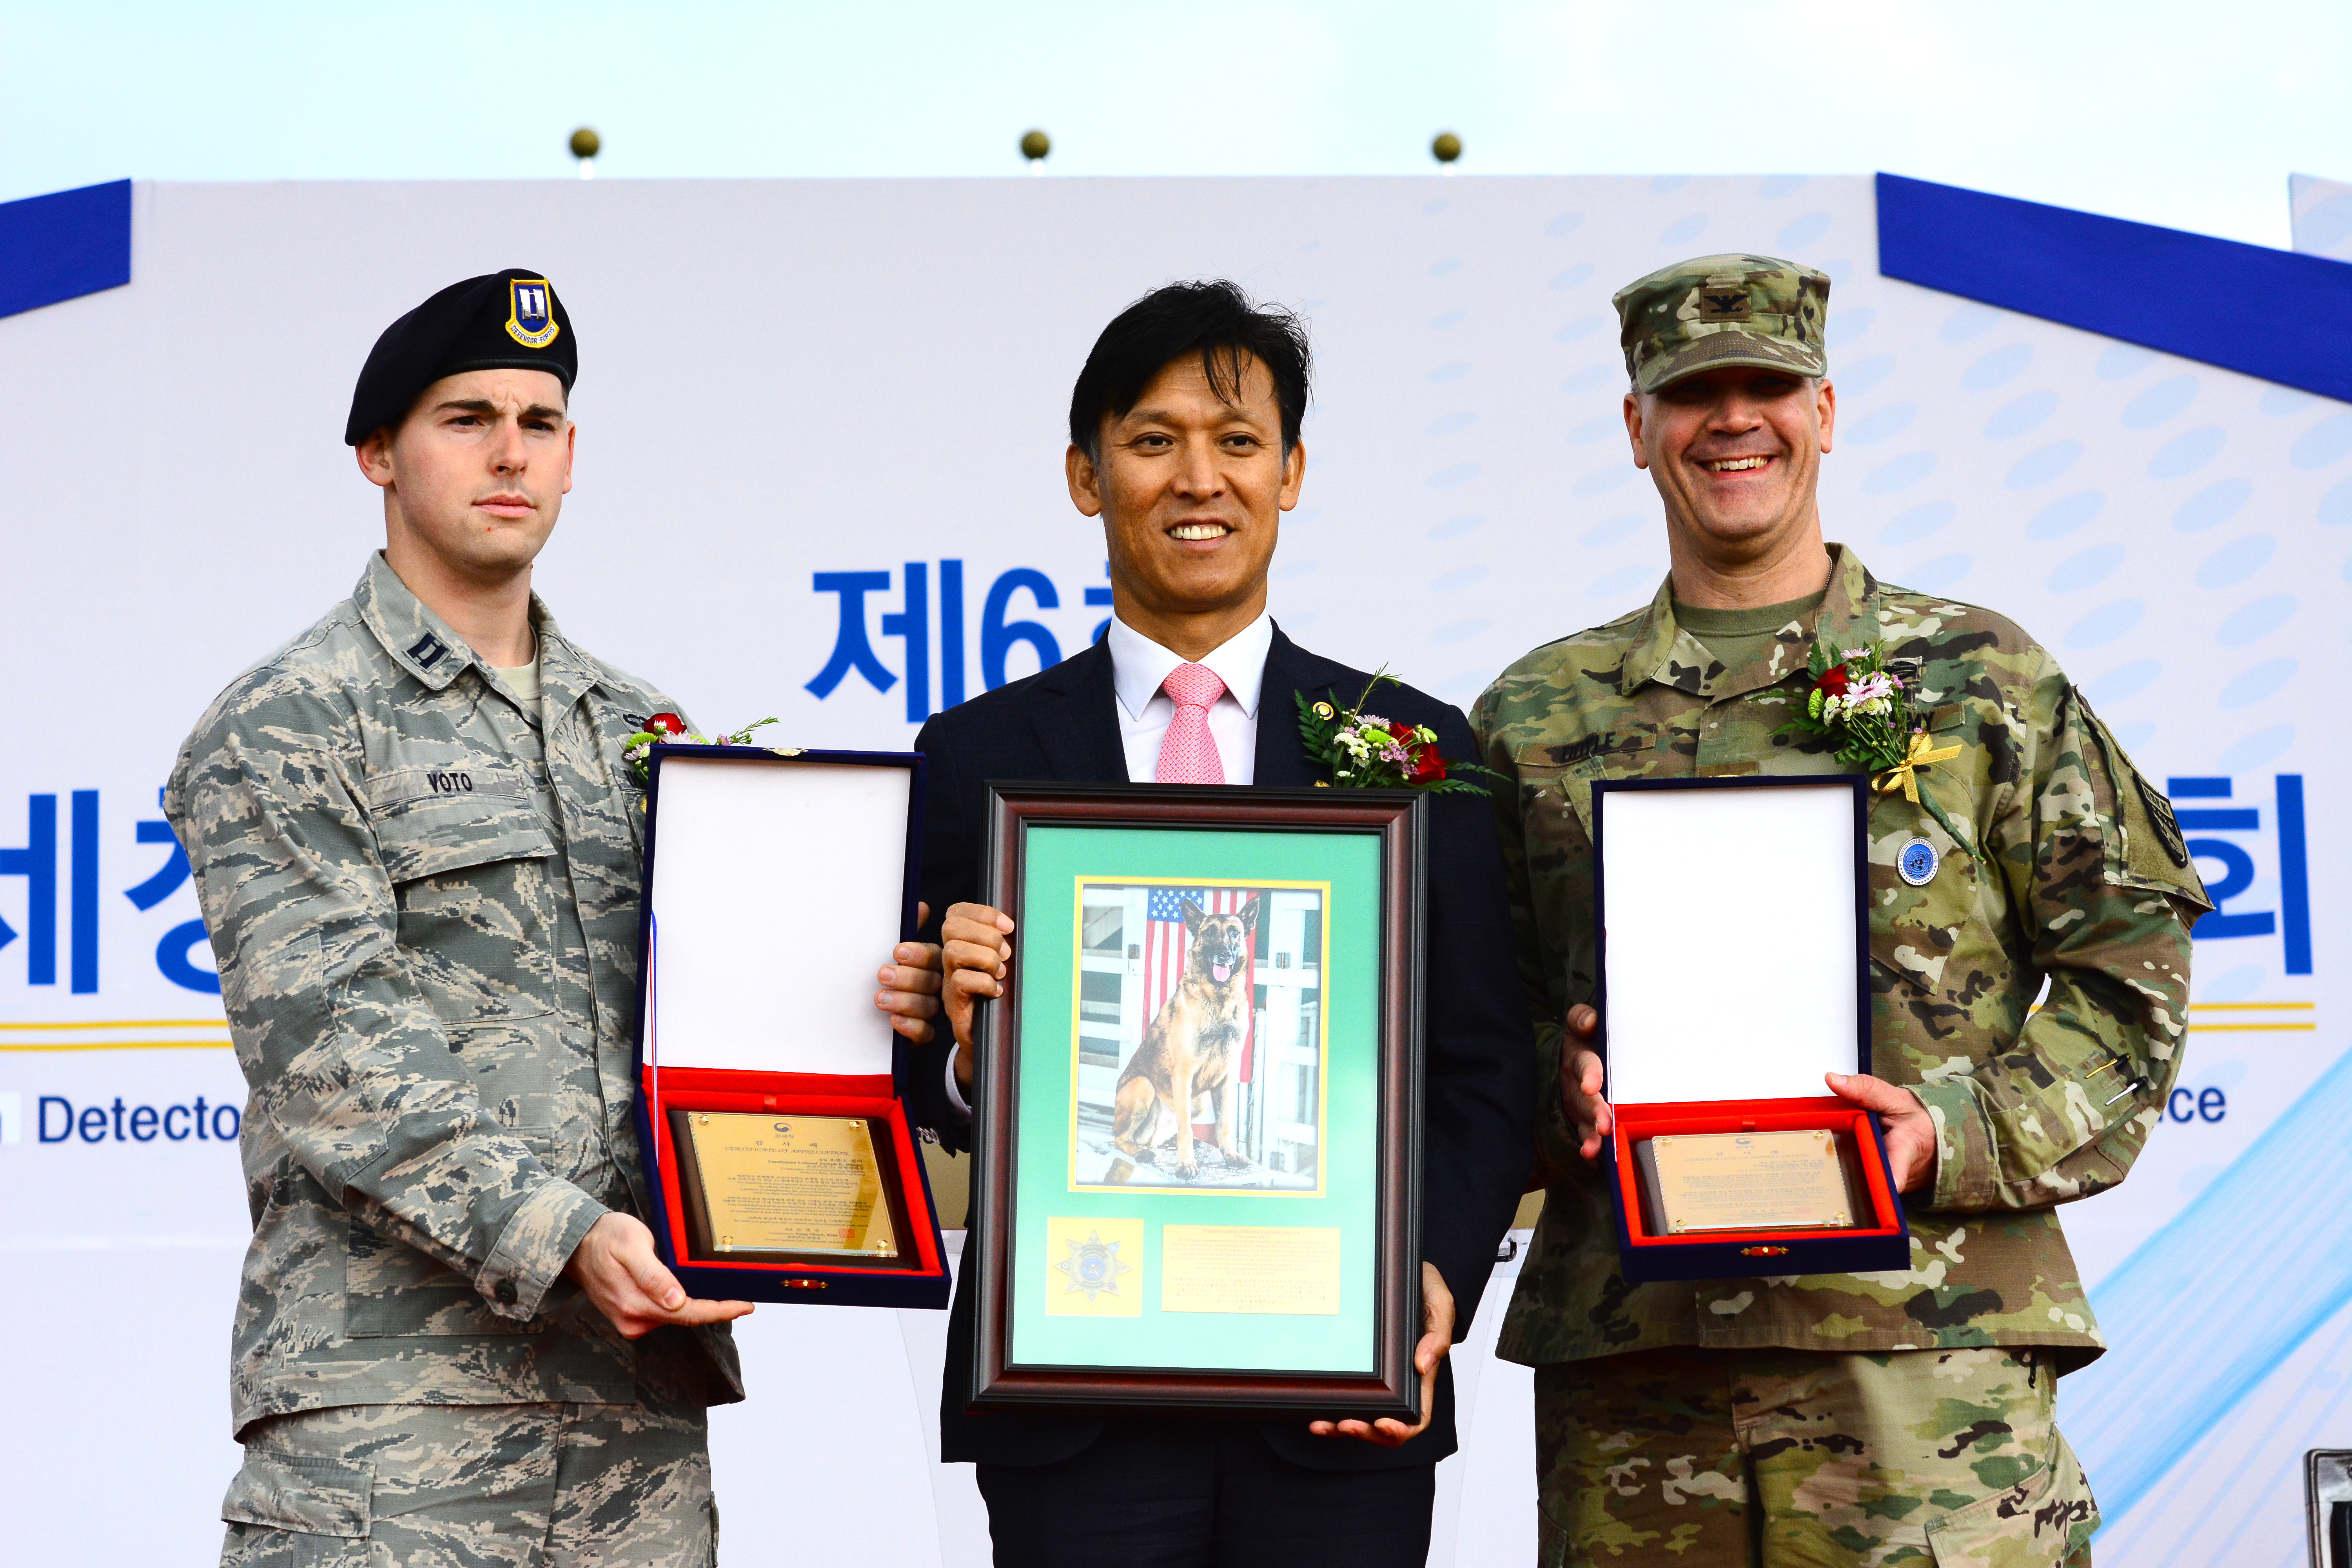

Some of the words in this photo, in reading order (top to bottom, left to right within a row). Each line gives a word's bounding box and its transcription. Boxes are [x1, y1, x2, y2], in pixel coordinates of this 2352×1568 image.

[511, 325, 537, 344] DEFENSOR
[1562, 731, 1616, 763] DOYLE
[426, 772, 473, 793] VOTO
[1898, 844, 1908, 861] UNITED
[1926, 842, 1938, 863] COMMAND
[2154, 1085, 2226, 1123] ce
[39, 1096, 240, 1143] Detecto
